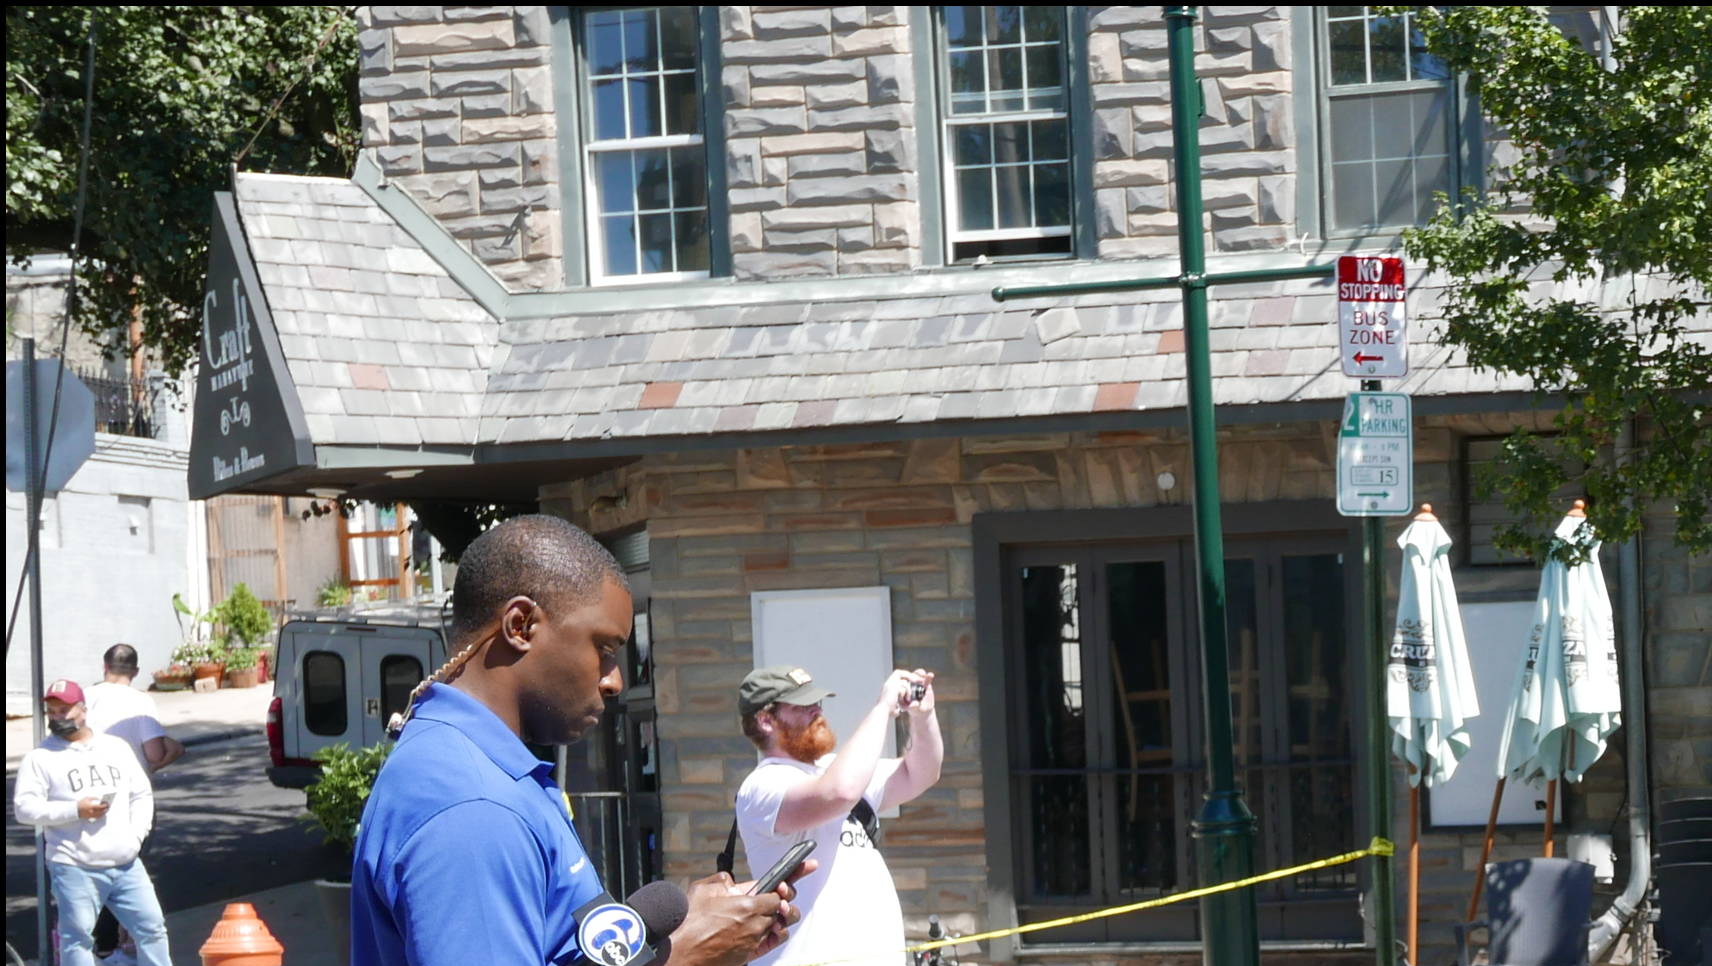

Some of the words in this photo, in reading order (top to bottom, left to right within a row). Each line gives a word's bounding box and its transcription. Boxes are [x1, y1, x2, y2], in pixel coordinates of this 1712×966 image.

[1356, 259, 1383, 282] NO
[1341, 283, 1407, 300] STOPPING
[1353, 310, 1389, 326] BUS
[203, 277, 252, 391] Craft
[1349, 329, 1396, 345] ZONE
[1375, 399, 1393, 414] HR
[1361, 418, 1407, 433] PARKING
[1379, 469, 1394, 483] 15
[67, 765, 121, 793] GAP
